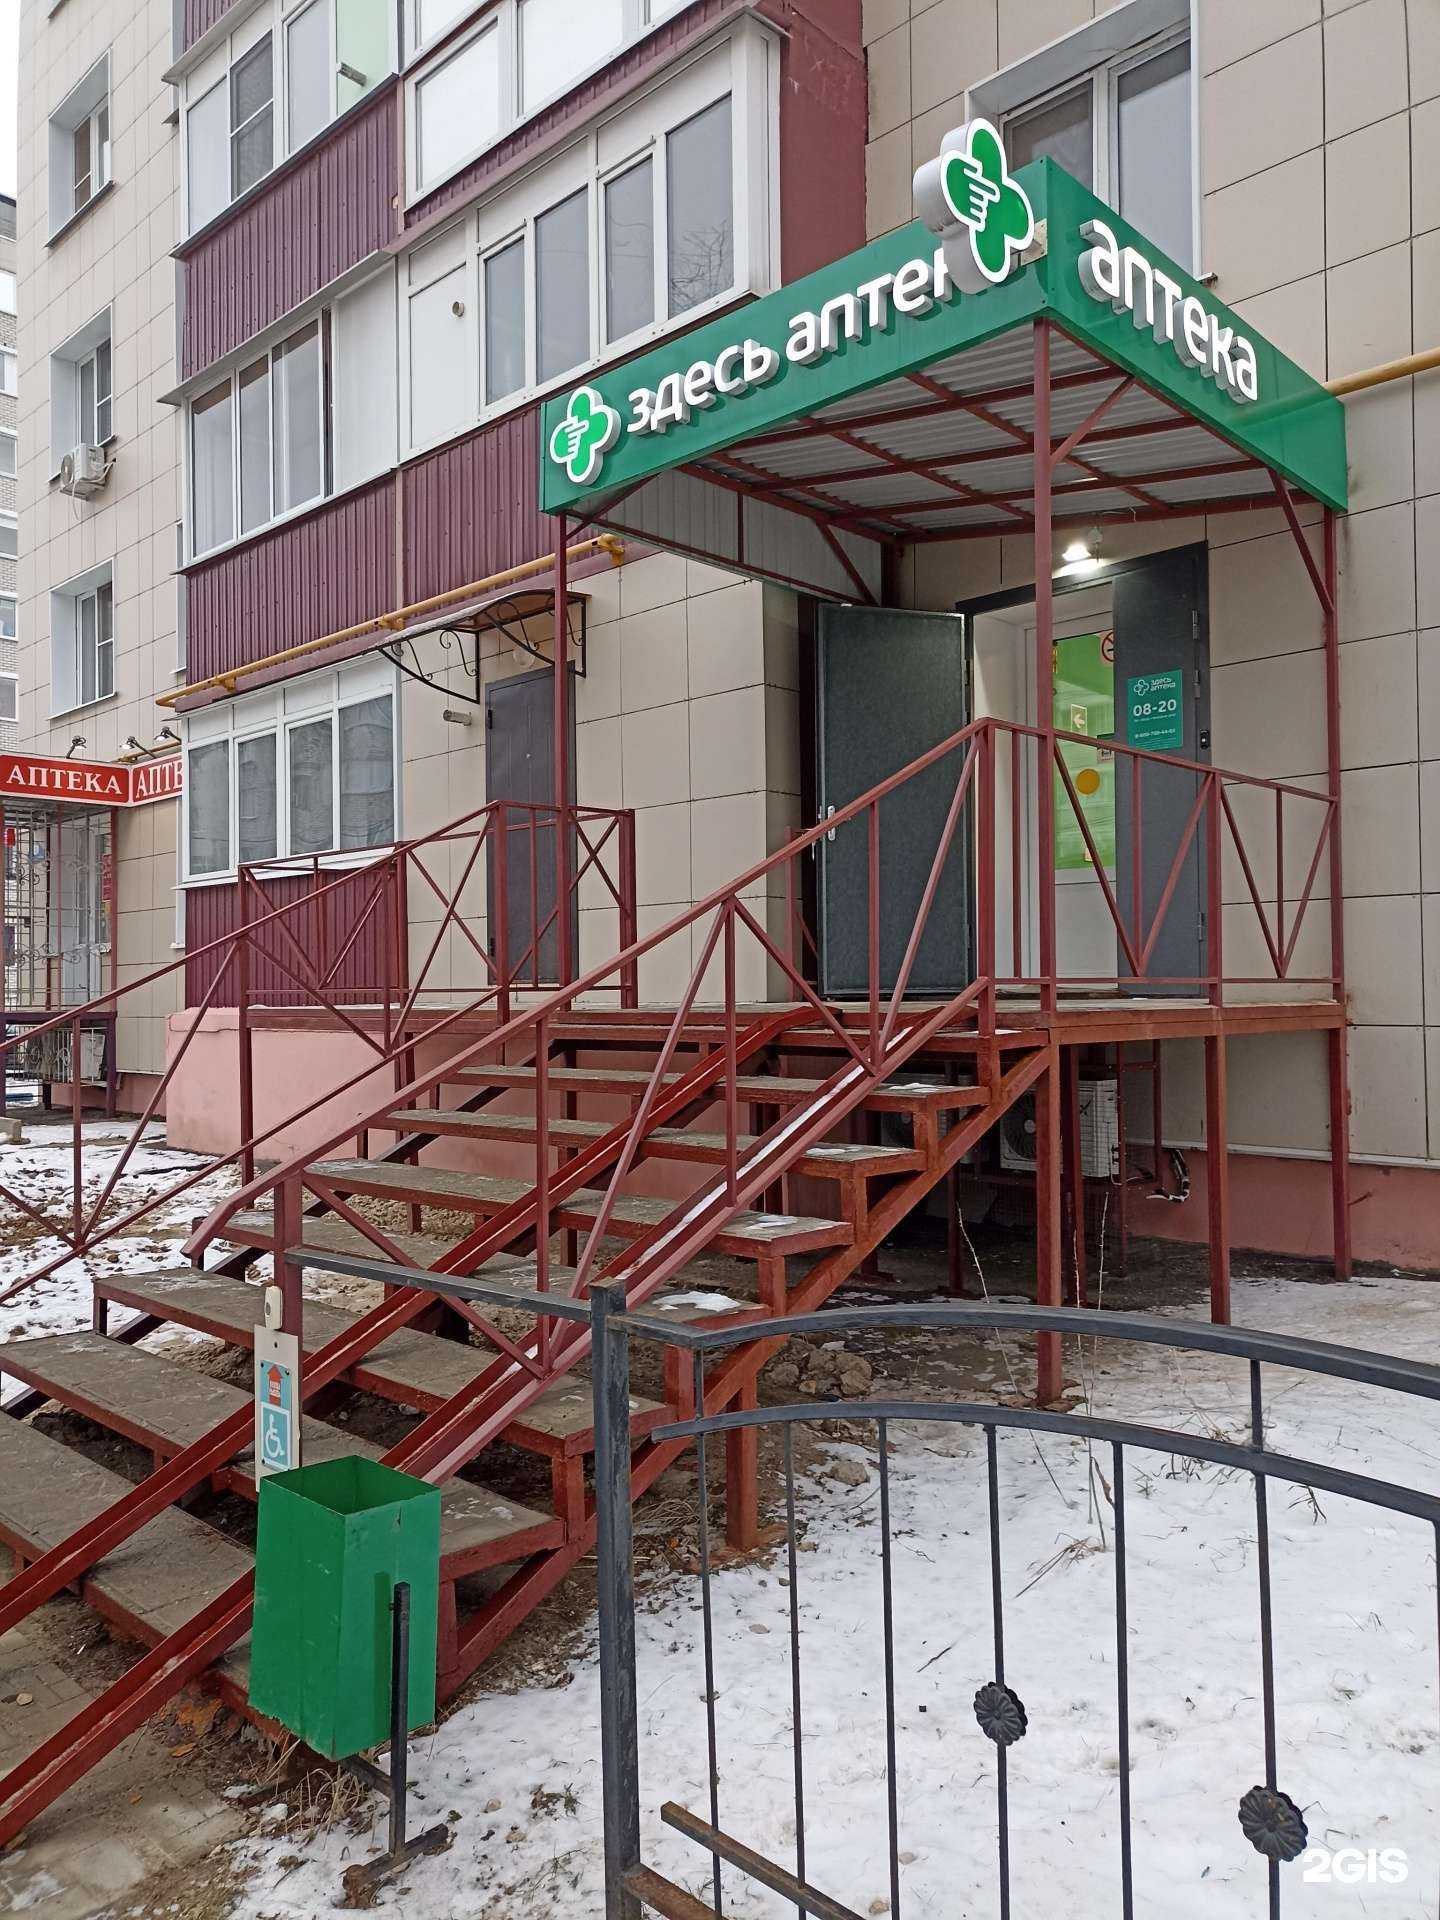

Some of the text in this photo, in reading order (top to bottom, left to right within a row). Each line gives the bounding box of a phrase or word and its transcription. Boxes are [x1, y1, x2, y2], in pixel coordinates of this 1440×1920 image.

[1079, 218, 1258, 404] аптека
[626, 338, 779, 434] здесь
[1132, 698, 1177, 717] 08-20
[6, 764, 122, 796] АПТЕКА
